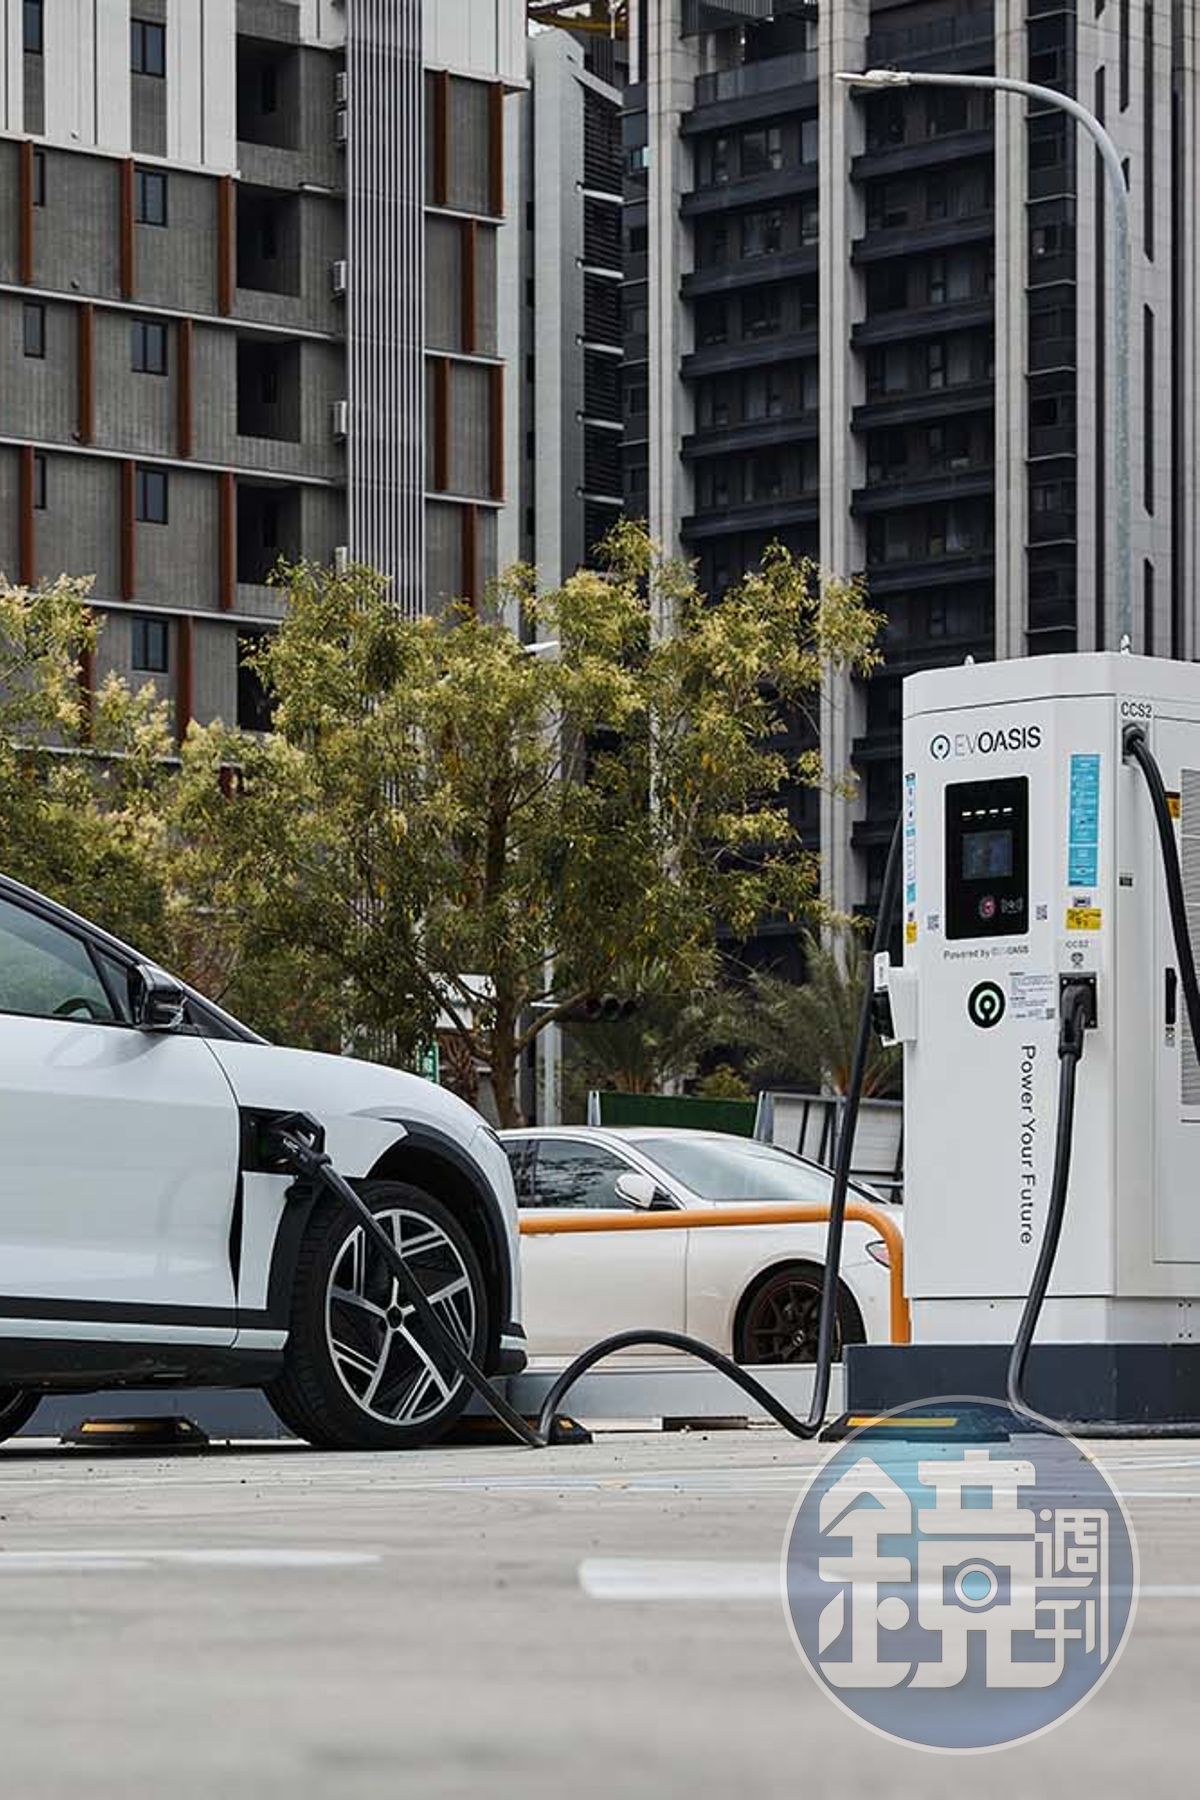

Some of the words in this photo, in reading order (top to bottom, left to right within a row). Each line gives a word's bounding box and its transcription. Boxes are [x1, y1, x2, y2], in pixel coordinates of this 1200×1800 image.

[1120, 701, 1152, 719] CCS2
[954, 726, 1041, 756] EVOASIS
[1021, 1045, 1036, 1113] Power
[1021, 1118, 1036, 1168] Your
[1020, 1174, 1036, 1244] Future
